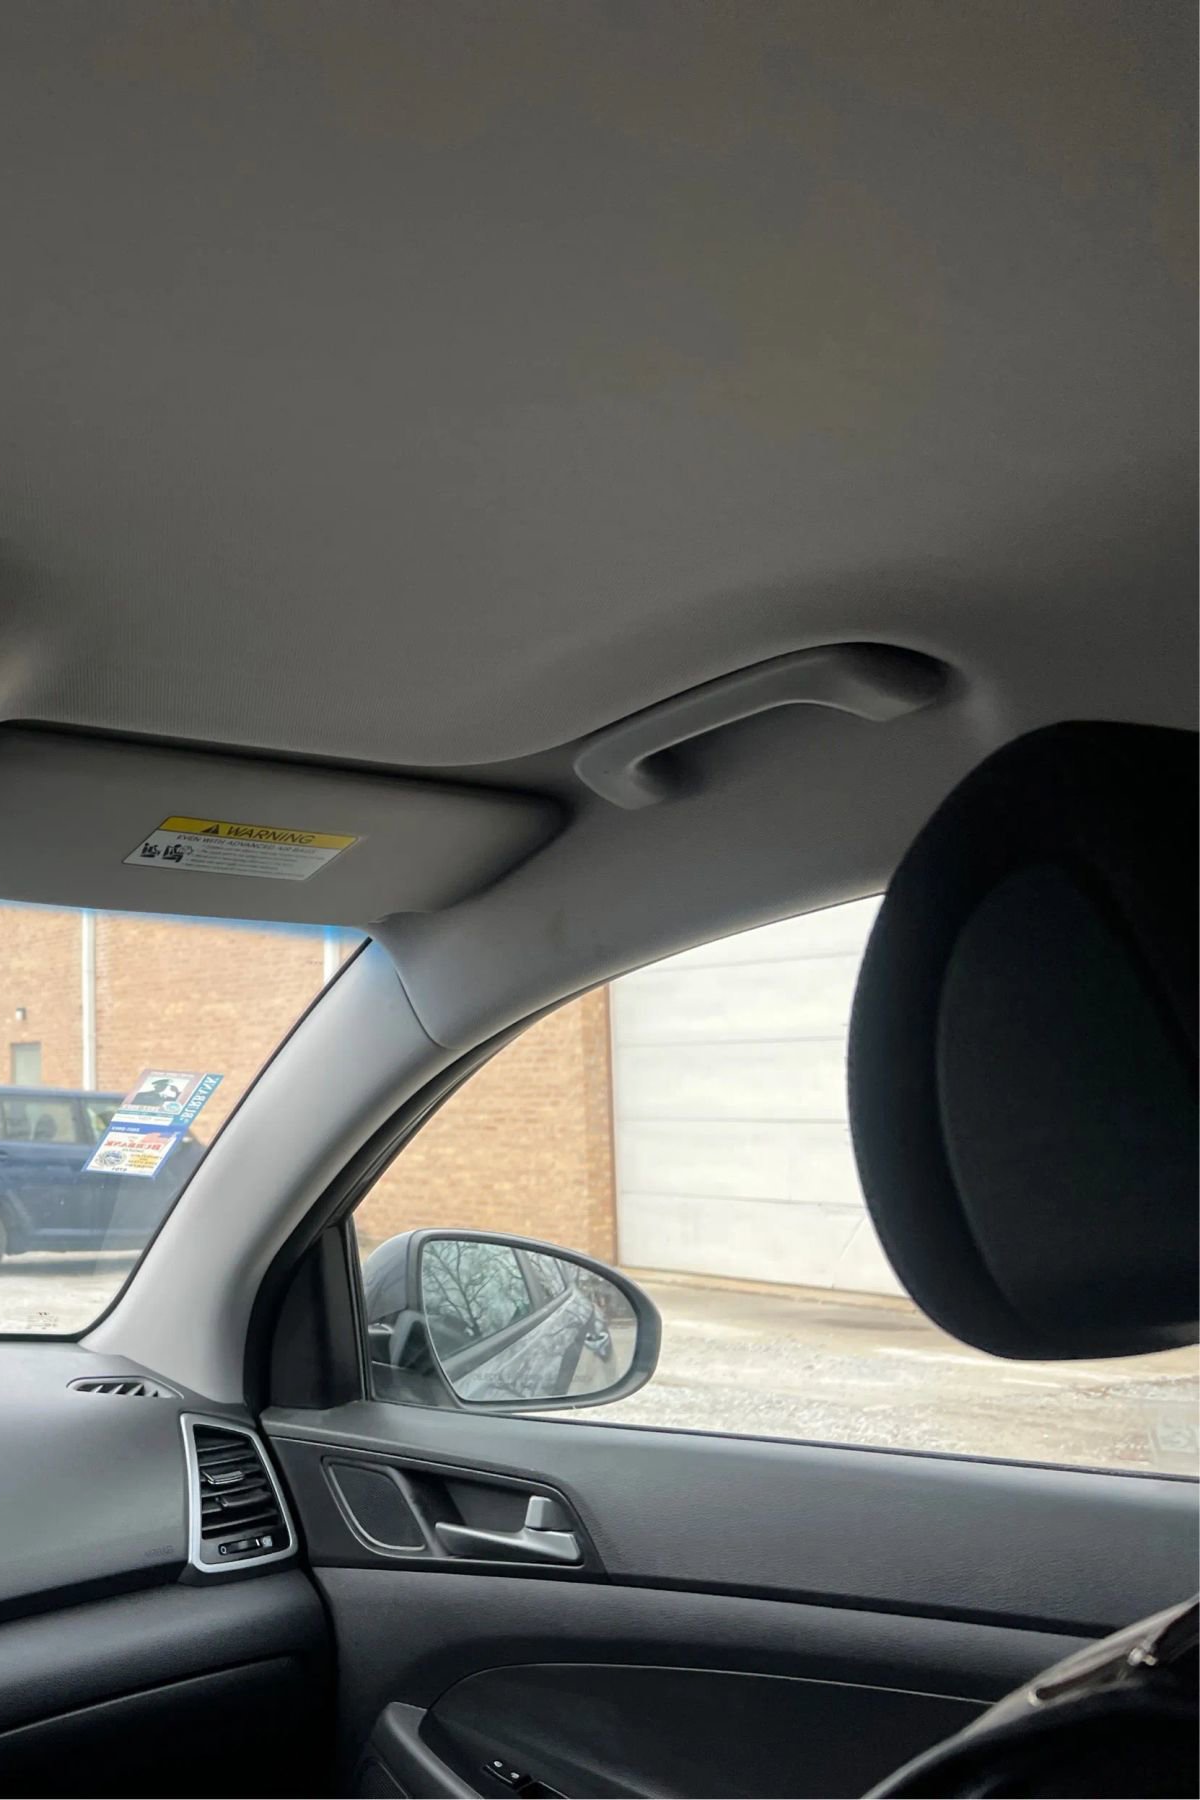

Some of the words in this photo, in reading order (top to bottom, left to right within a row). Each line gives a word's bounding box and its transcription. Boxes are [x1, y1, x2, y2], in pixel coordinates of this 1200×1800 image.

[176, 834, 200, 843] EVEN
[202, 836, 225, 846] WITH
[227, 839, 277, 851] ADVANCED
[226, 826, 316, 845] WARNING
